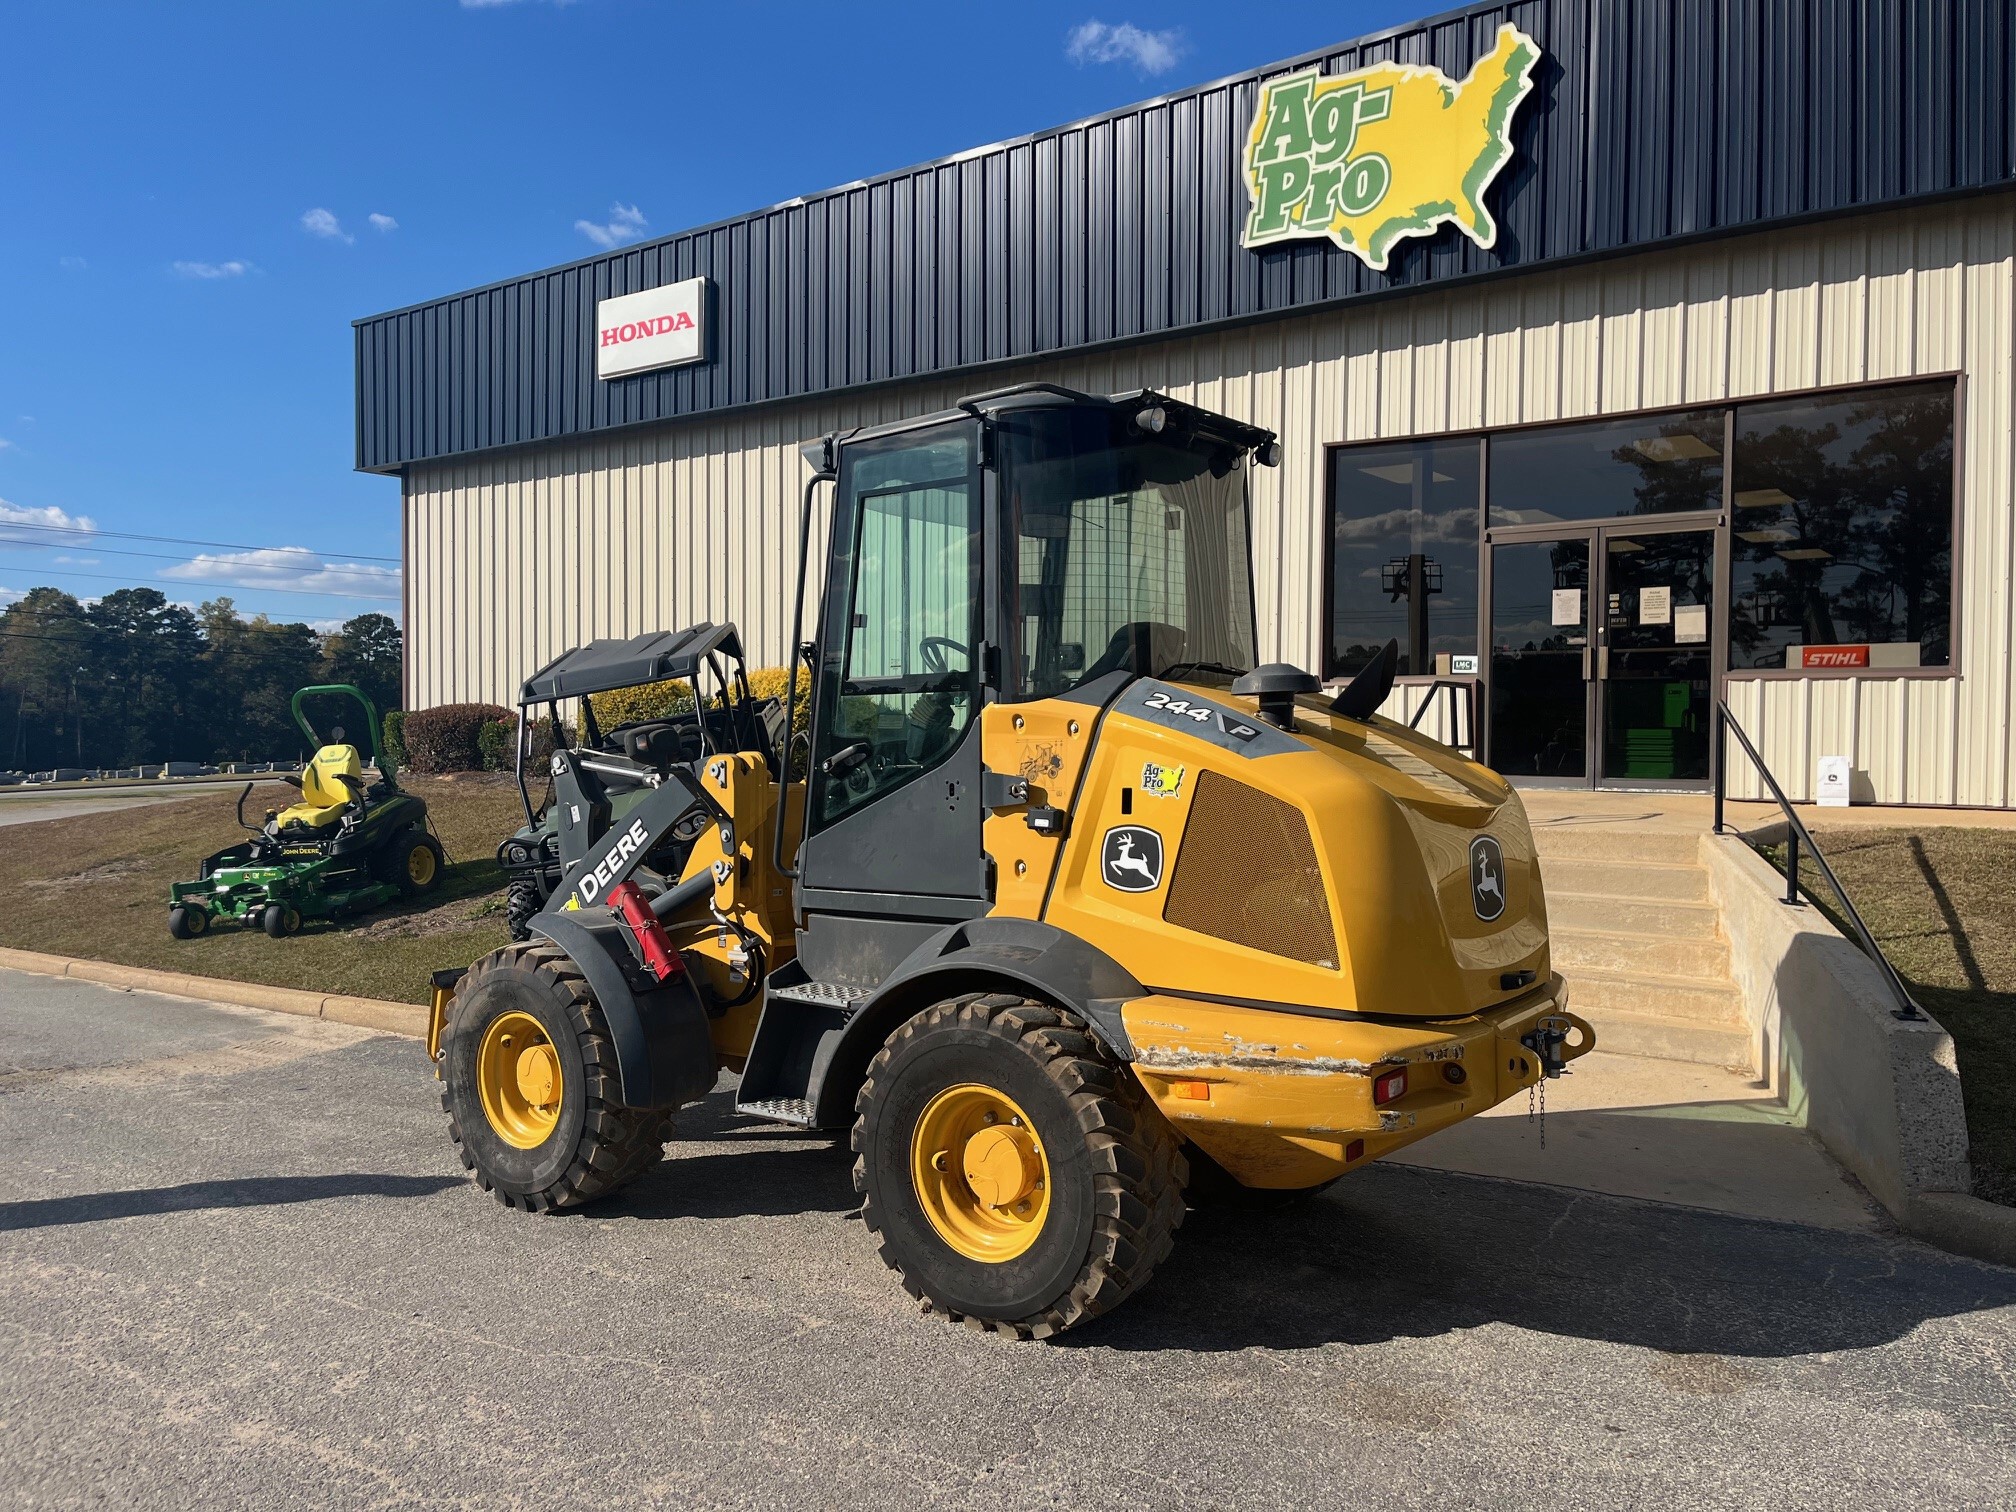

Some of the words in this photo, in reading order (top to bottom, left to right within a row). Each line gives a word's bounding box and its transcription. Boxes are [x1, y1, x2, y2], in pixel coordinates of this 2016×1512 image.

[1251, 75, 1393, 168] Ag-
[1249, 154, 1390, 238] Pro
[600, 311, 696, 348] HONDA
[1454, 660, 1472, 668] LMC
[1806, 652, 1862, 666] STIHL
[1142, 692, 1214, 722] 244
[1143, 763, 1164, 779] Ag-
[1143, 775, 1164, 788] Pro
[577, 817, 650, 904] DEERE
